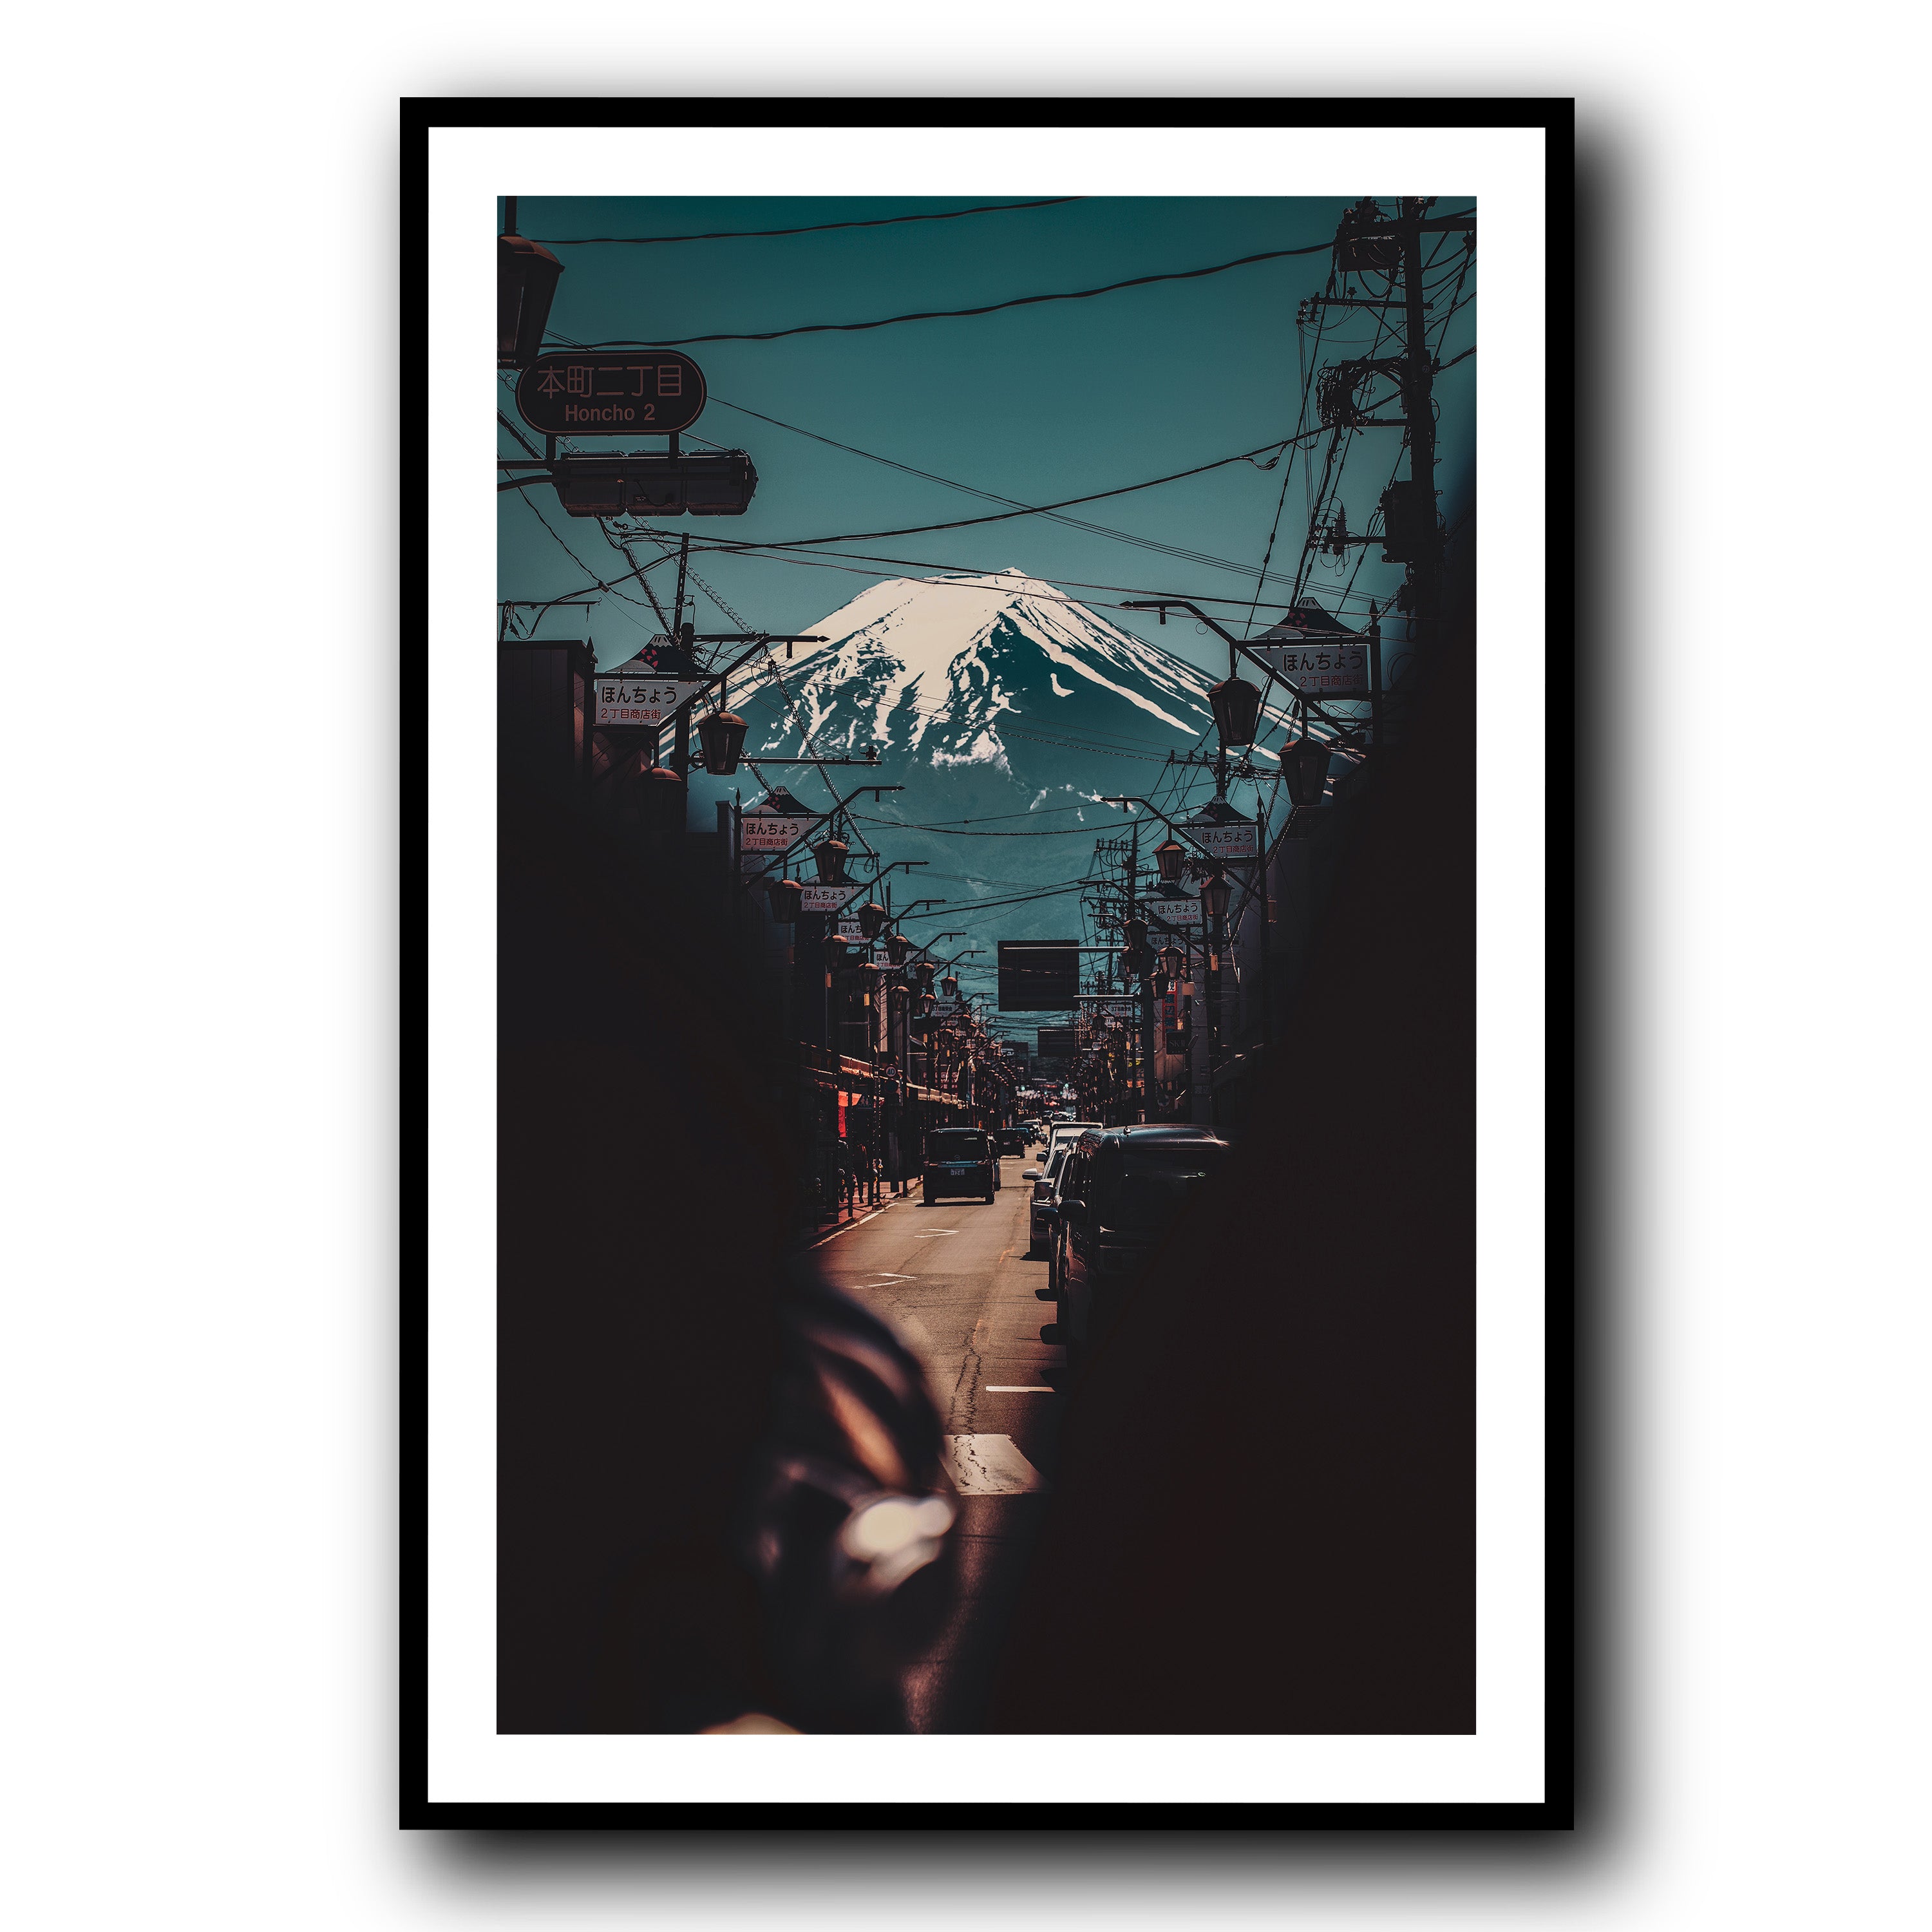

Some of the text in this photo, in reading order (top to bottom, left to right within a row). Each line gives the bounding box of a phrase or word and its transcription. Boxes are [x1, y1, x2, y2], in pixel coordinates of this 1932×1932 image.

[536, 364, 683, 399] 本町二丁目
[565, 403, 656, 422] Honcho 2
[1283, 650, 1363, 672] ほんちょう
[1300, 674, 1363, 687] 2丁目商店街
[601, 686, 677, 704] ほんちょう
[601, 708, 661, 719] 2丁目商店街
[746, 822, 799, 835] ほんちょう
[1202, 830, 1253, 843] ほんちょう
[804, 890, 846, 900] ほんちょう
[1158, 902, 1198, 914] ほんちょう
[841, 925, 862, 933] ほんち
